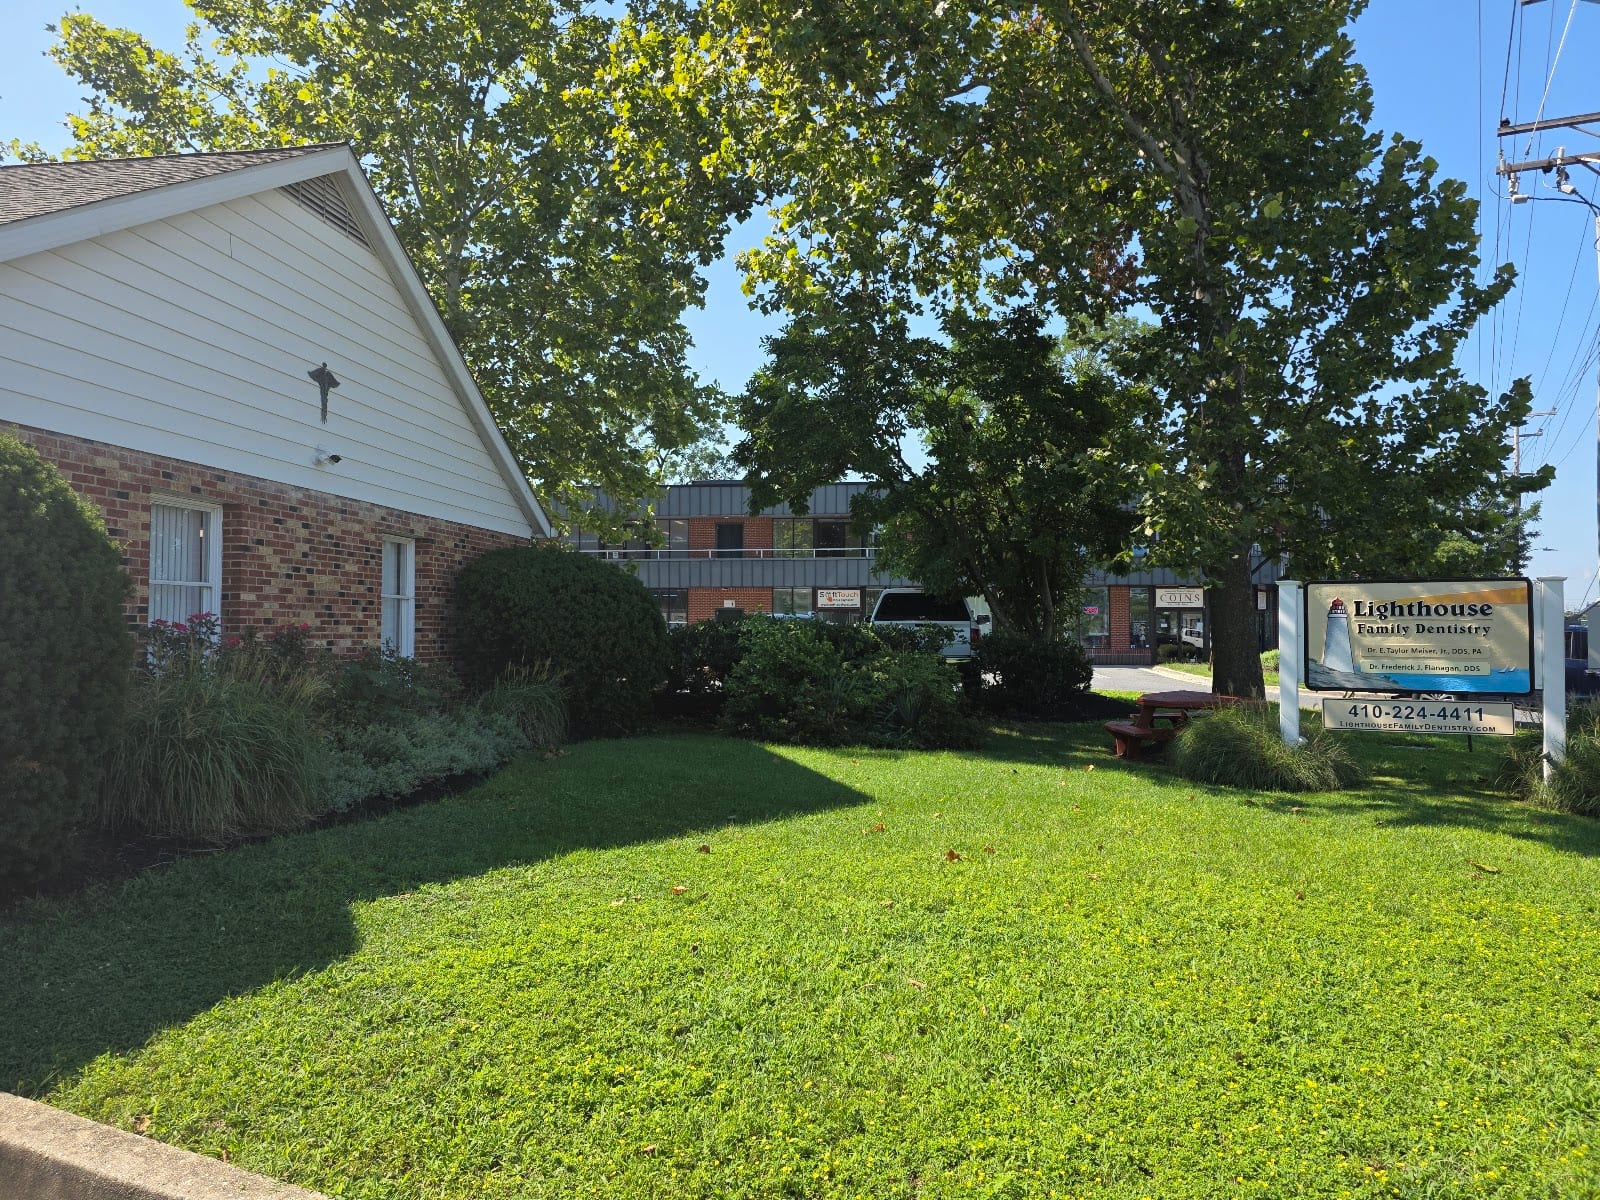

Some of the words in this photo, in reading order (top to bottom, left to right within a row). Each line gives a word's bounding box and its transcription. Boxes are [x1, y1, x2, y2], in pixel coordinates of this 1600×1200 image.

[1159, 593, 1200, 602] COINS
[1353, 600, 1493, 620] Lighthouse
[1357, 623, 1409, 636] Family
[1415, 623, 1491, 637] Dentistry
[1386, 647, 1409, 655] Taylor
[1381, 663, 1415, 671] Frederick
[1348, 704, 1484, 722] 410-224-4411
